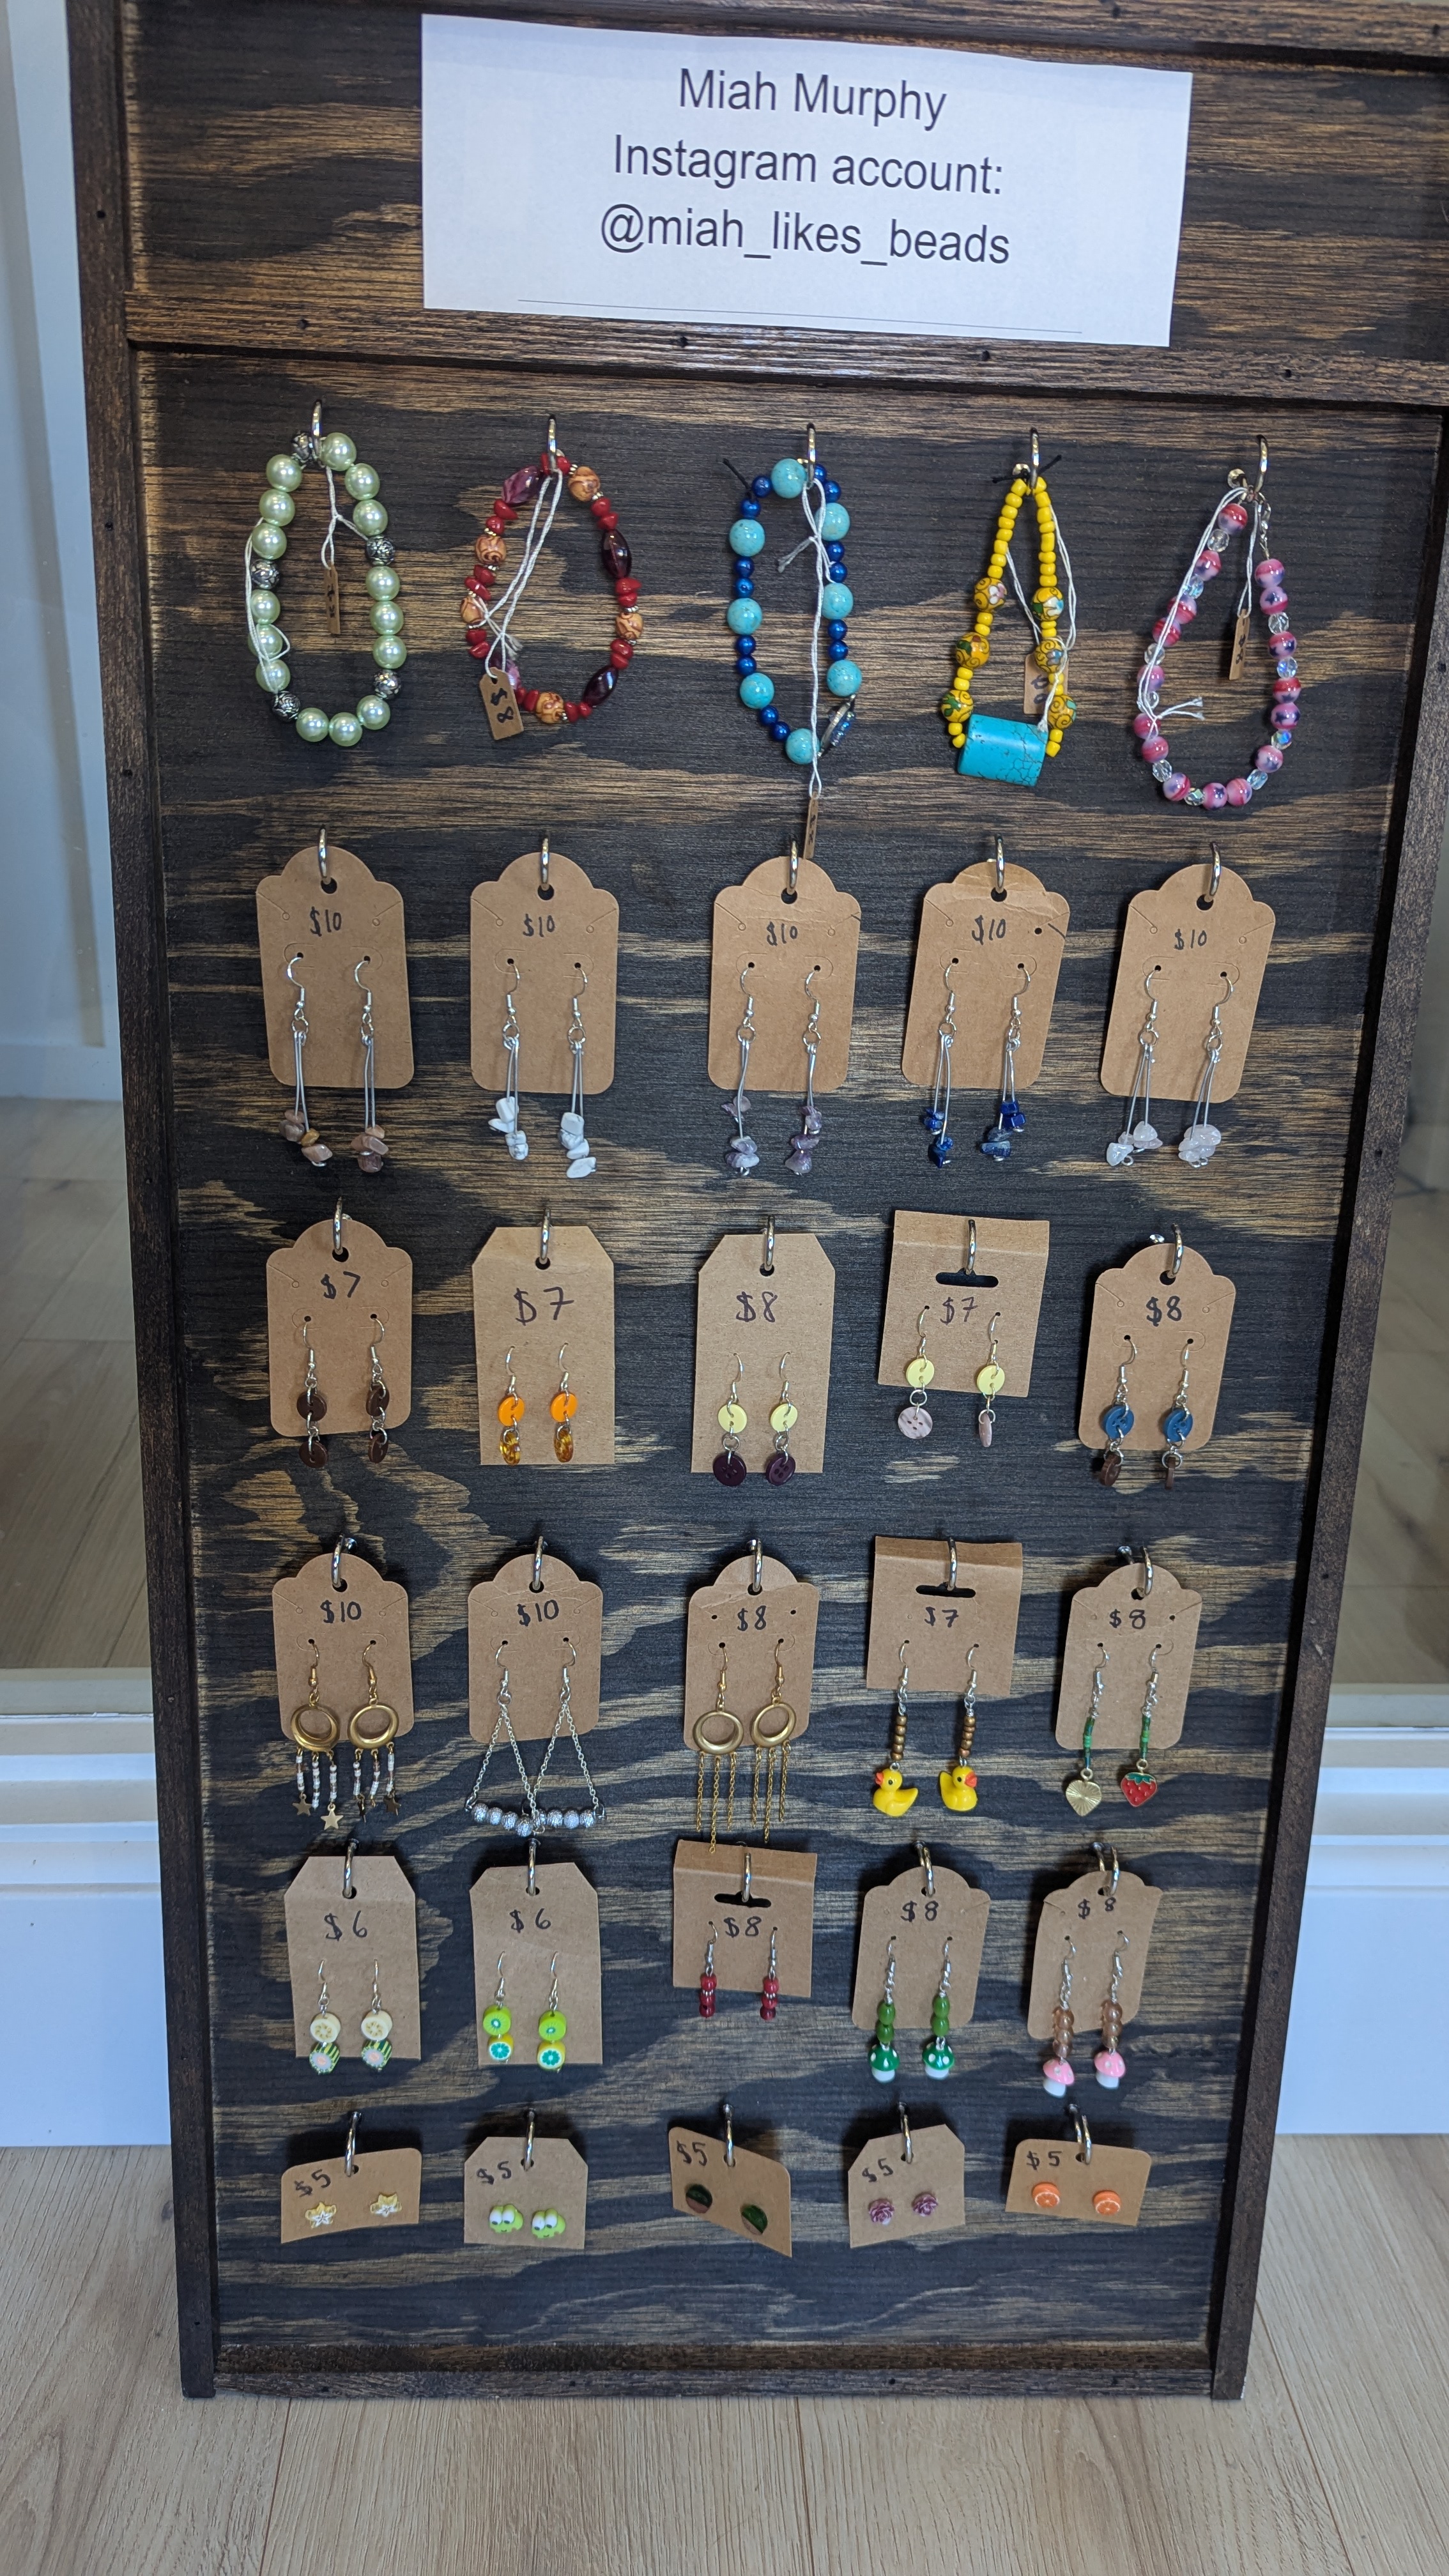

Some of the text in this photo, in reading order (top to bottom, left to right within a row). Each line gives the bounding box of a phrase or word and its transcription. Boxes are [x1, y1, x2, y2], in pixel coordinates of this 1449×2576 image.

[680, 68, 947, 132] Miah Murphy
[615, 134, 1002, 195] Instagram account:
[601, 203, 1009, 266] @miah_likes_beads
[490, 687, 514, 723] $8
[309, 906, 342, 937] $10
[522, 913, 555, 938] $10
[766, 921, 798, 947] $10
[971, 914, 1006, 946] $10
[1173, 928, 1208, 951] $10
[320, 1271, 361, 1300] $7
[513, 1286, 574, 1326] $7
[735, 1291, 778, 1323] $8
[940, 1296, 978, 1326] $7
[1146, 1295, 1182, 1327] $8
[319, 1599, 362, 1624] $10
[516, 1599, 560, 1627] $10
[737, 1605, 767, 1632] $8
[924, 1606, 960, 1629] $7
[1109, 1608, 1146, 1630] $8
[509, 1908, 551, 1934] $6
[900, 1900, 939, 1923] $8
[1077, 1896, 1117, 1920] $8
[323, 1910, 368, 1942] $6
[723, 1915, 762, 1938] $8
[676, 2140, 708, 2166] $5
[1026, 2150, 1062, 2171] $5
[294, 2168, 332, 2198] $5
[477, 2160, 512, 2186] $5
[861, 2158, 894, 2183] $5
